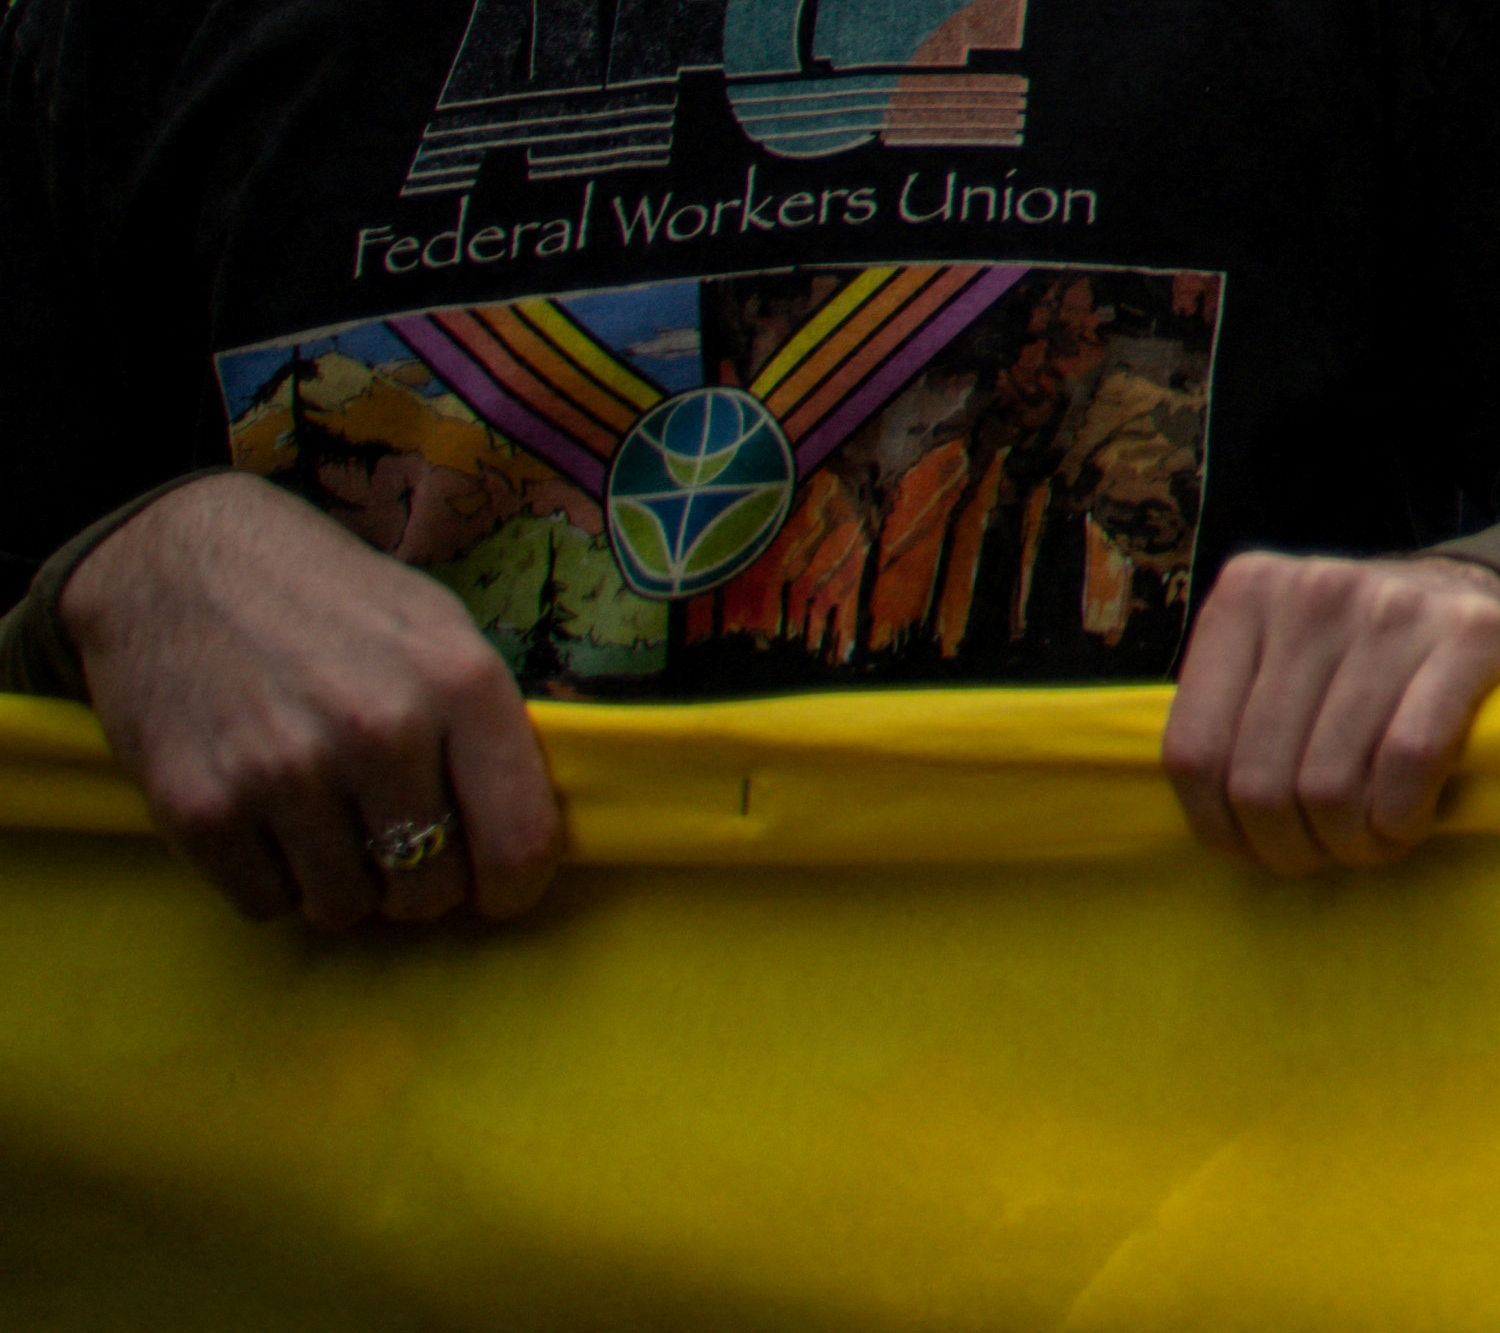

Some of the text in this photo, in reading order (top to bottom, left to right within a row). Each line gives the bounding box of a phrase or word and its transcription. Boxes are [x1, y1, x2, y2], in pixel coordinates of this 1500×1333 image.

[352, 162, 1098, 280] Federal Workers Union
